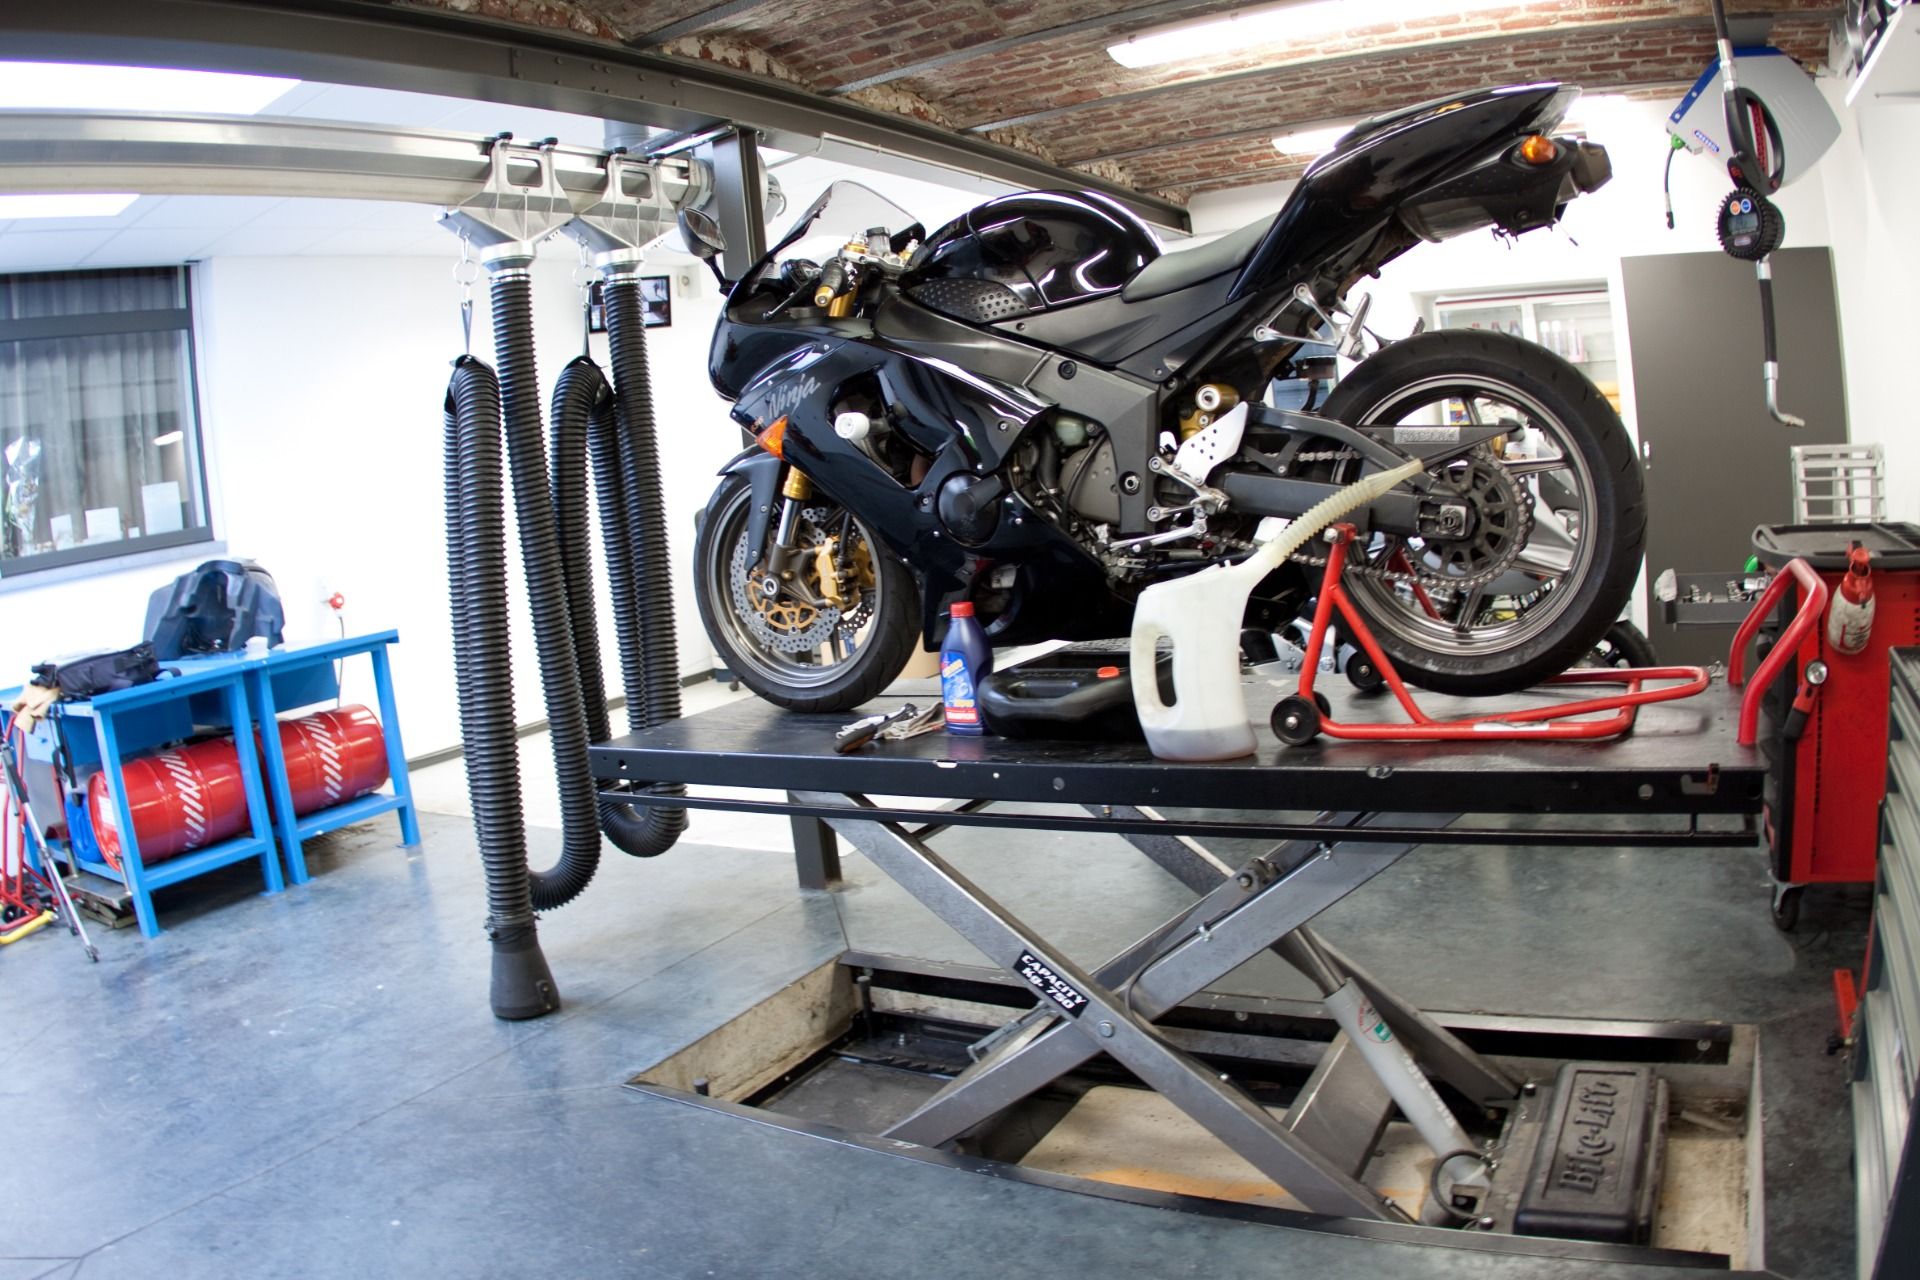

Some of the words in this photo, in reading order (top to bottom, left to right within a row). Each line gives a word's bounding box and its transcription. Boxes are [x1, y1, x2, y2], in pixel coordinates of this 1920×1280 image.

[768, 374, 822, 418] Ninja
[1021, 955, 1086, 1004] CAPACITY
[1046, 986, 1076, 1009] 750
